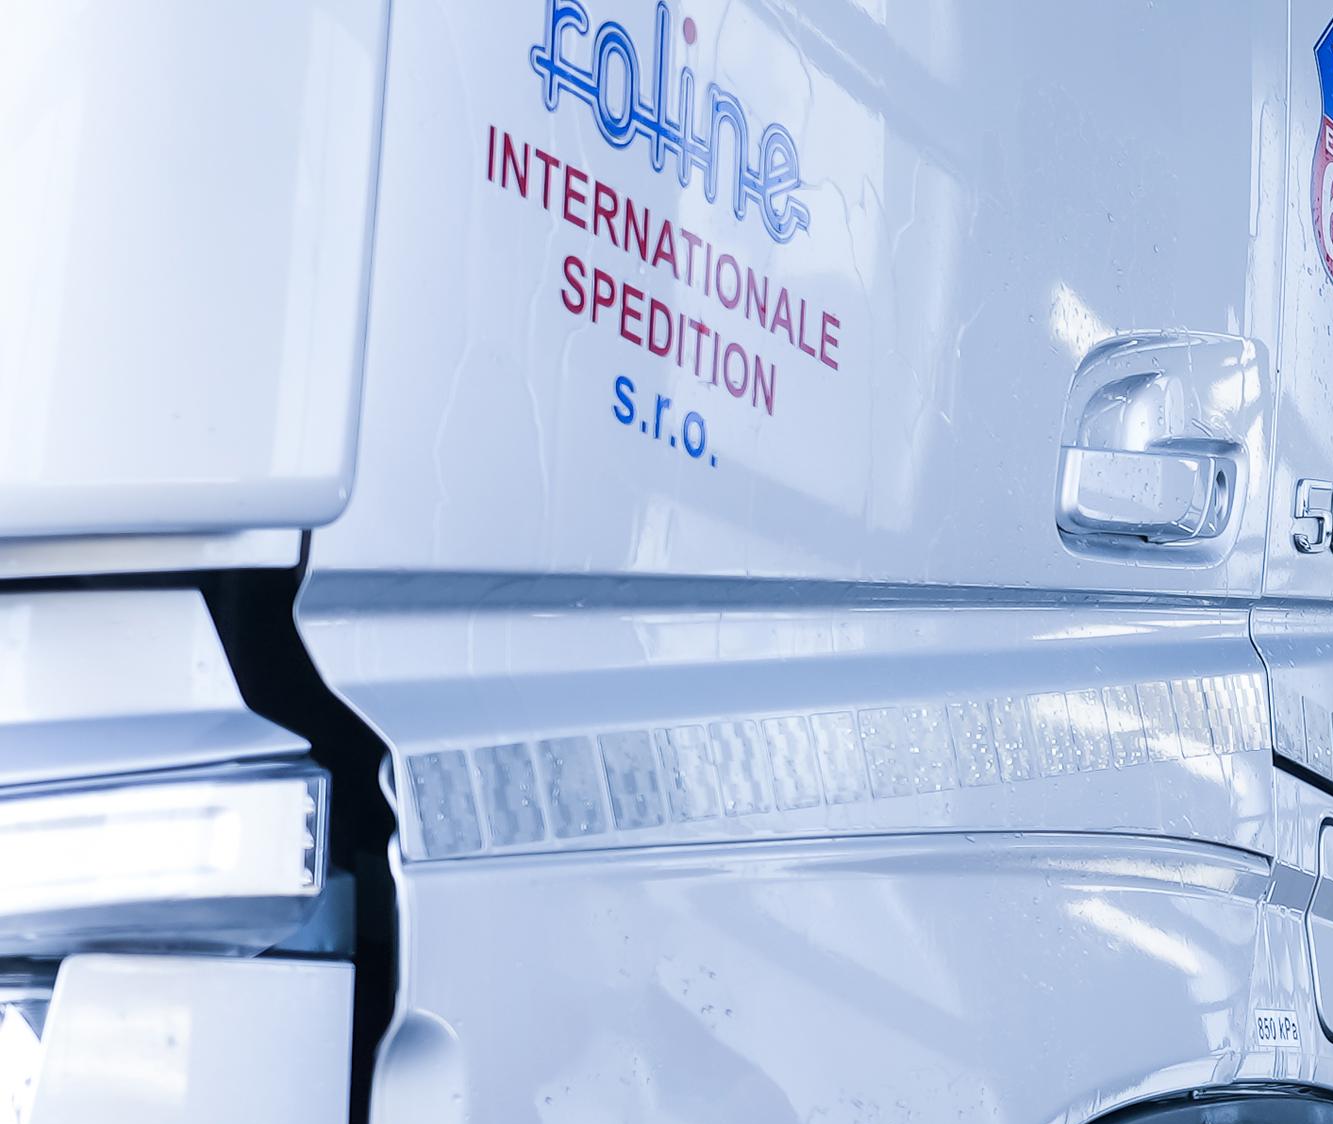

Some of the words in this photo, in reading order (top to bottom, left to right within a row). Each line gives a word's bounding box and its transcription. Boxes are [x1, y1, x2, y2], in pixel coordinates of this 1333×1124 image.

[530, 0, 810, 244] roline
[486, 124, 841, 371] INTERNATIONALE
[561, 255, 776, 416] SPEDITION
[612, 374, 718, 468] s.r.o.
[1258, 1017, 1276, 1040] 850
[1279, 1017, 1298, 1040] kPa
